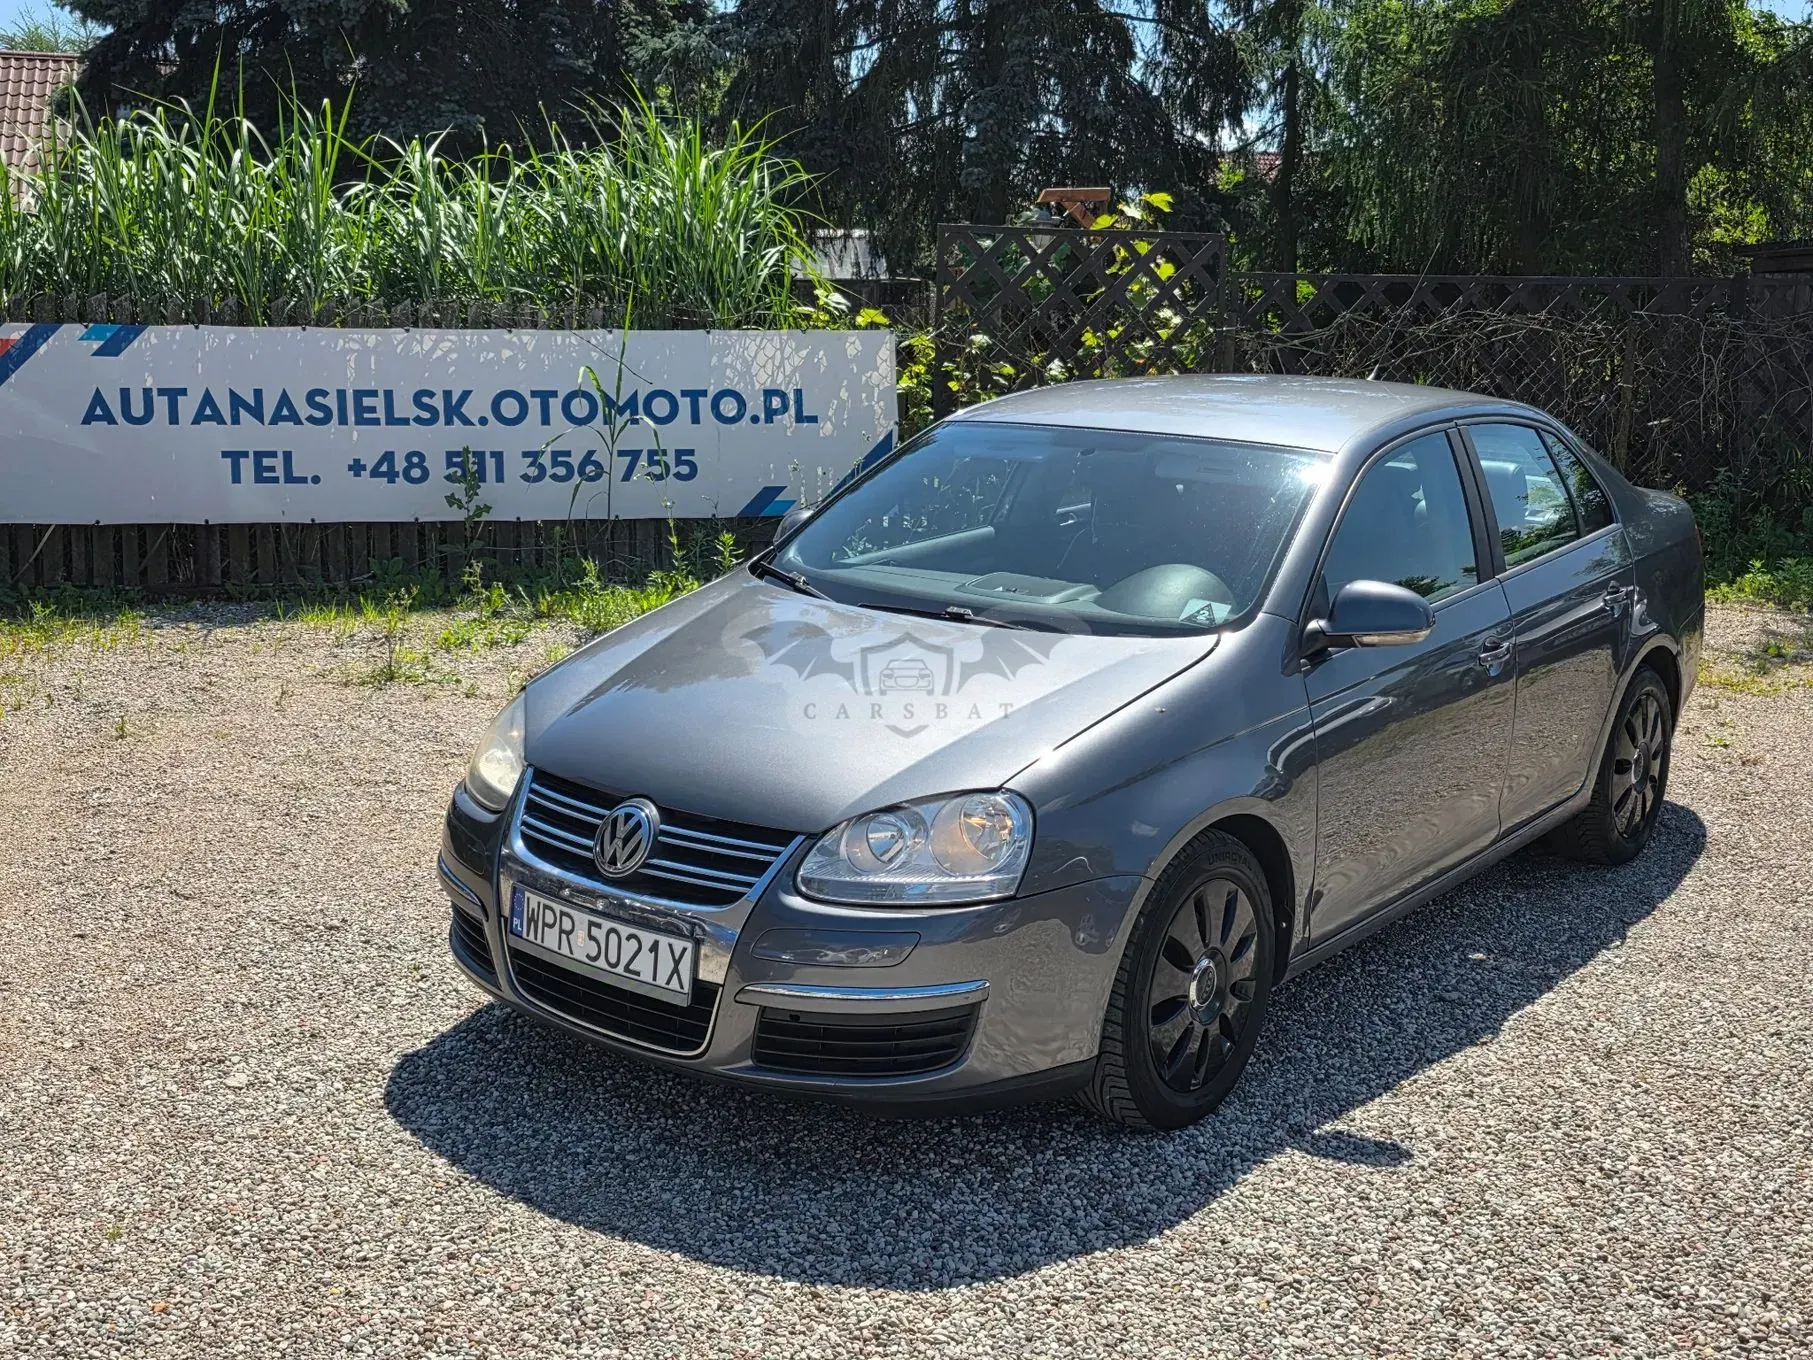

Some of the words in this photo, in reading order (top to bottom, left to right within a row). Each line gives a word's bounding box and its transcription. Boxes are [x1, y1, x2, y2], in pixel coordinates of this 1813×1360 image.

[80, 387, 818, 426] AUTANASIELSK.OTOMOTO.PL
[221, 450, 321, 484] TEL.
[348, 450, 430, 484] +48
[519, 449, 605, 484] 356
[616, 448, 699, 483] 755
[512, 917, 522, 931] PL
[525, 896, 575, 955] WPR
[585, 919, 688, 990] 5021X
